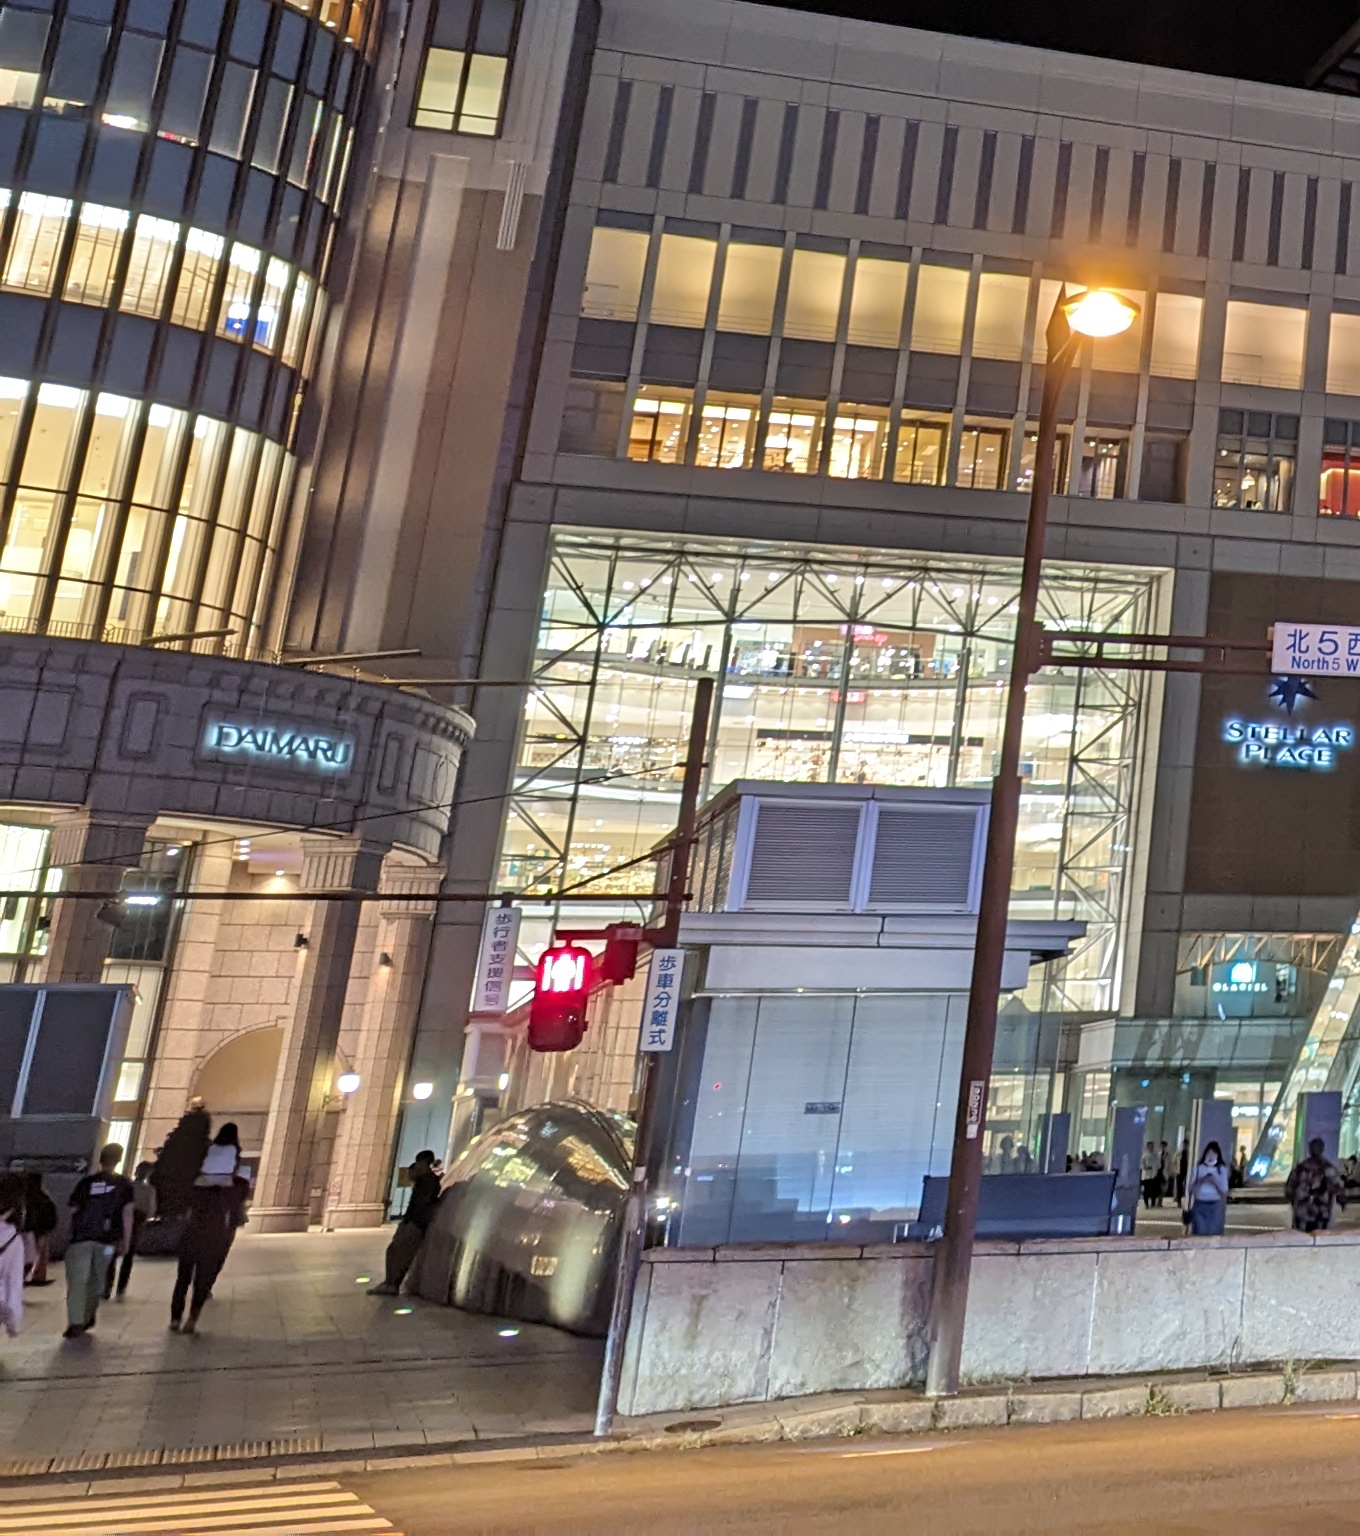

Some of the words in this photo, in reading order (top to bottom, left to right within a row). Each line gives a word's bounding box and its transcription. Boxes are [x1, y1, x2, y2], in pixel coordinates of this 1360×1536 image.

[214, 724, 350, 764] DAIMARU
[1227, 721, 1352, 744] STELLAR
[1244, 743, 1332, 763] PLACE
[648, 955, 677, 1046] 歩車分離式
